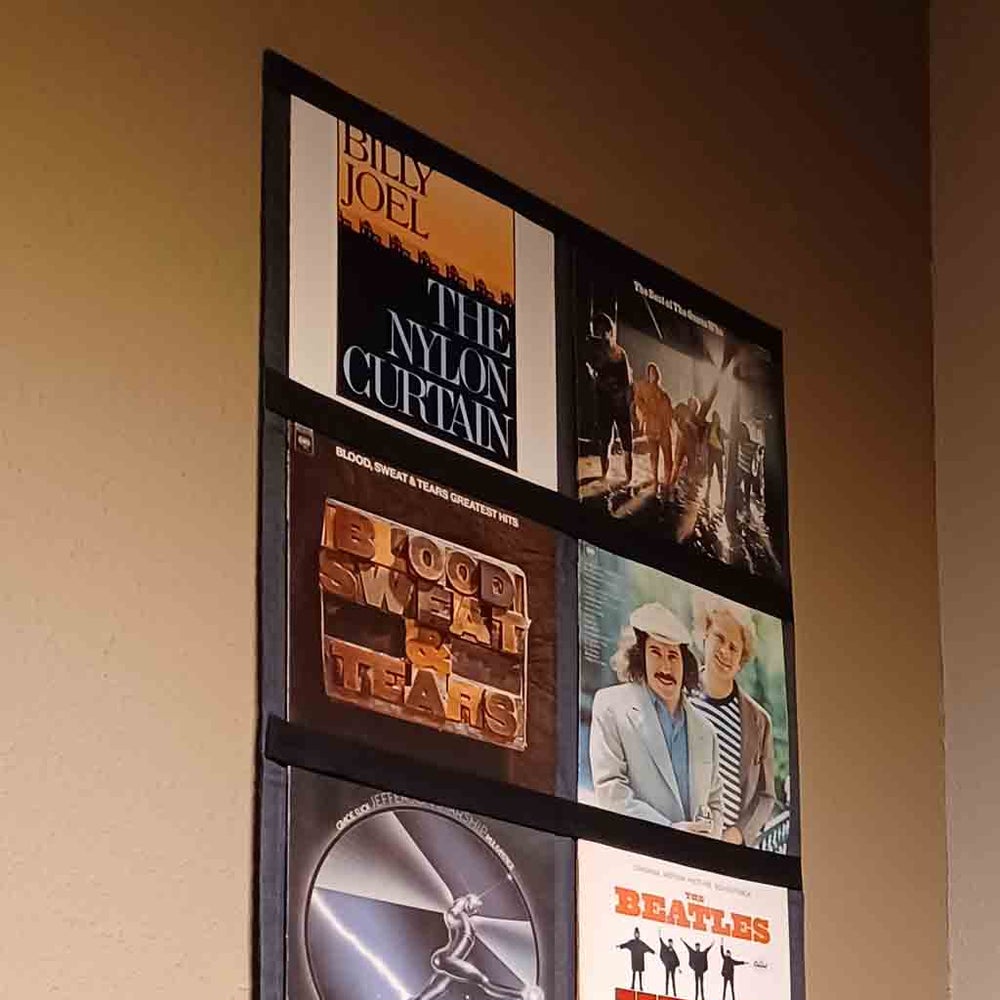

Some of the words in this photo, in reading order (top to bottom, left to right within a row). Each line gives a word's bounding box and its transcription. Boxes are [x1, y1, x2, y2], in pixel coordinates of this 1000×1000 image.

[344, 121, 433, 196] BILLY
[341, 162, 430, 240] JOEL
[386, 308, 512, 408] NYLON
[427, 278, 511, 359] THE
[342, 345, 514, 459] CURTAIN
[335, 445, 373, 471] BLOOD,
[374, 461, 409, 485] SWEAT
[409, 475, 416, 488] &
[417, 478, 449, 501] TEARS
[450, 492, 499, 519] GREATEST
[498, 511, 519, 529] HITS
[328, 641, 519, 741] TEARS
[614, 886, 771, 945] BEATLES
[685, 891, 704, 903] THE
